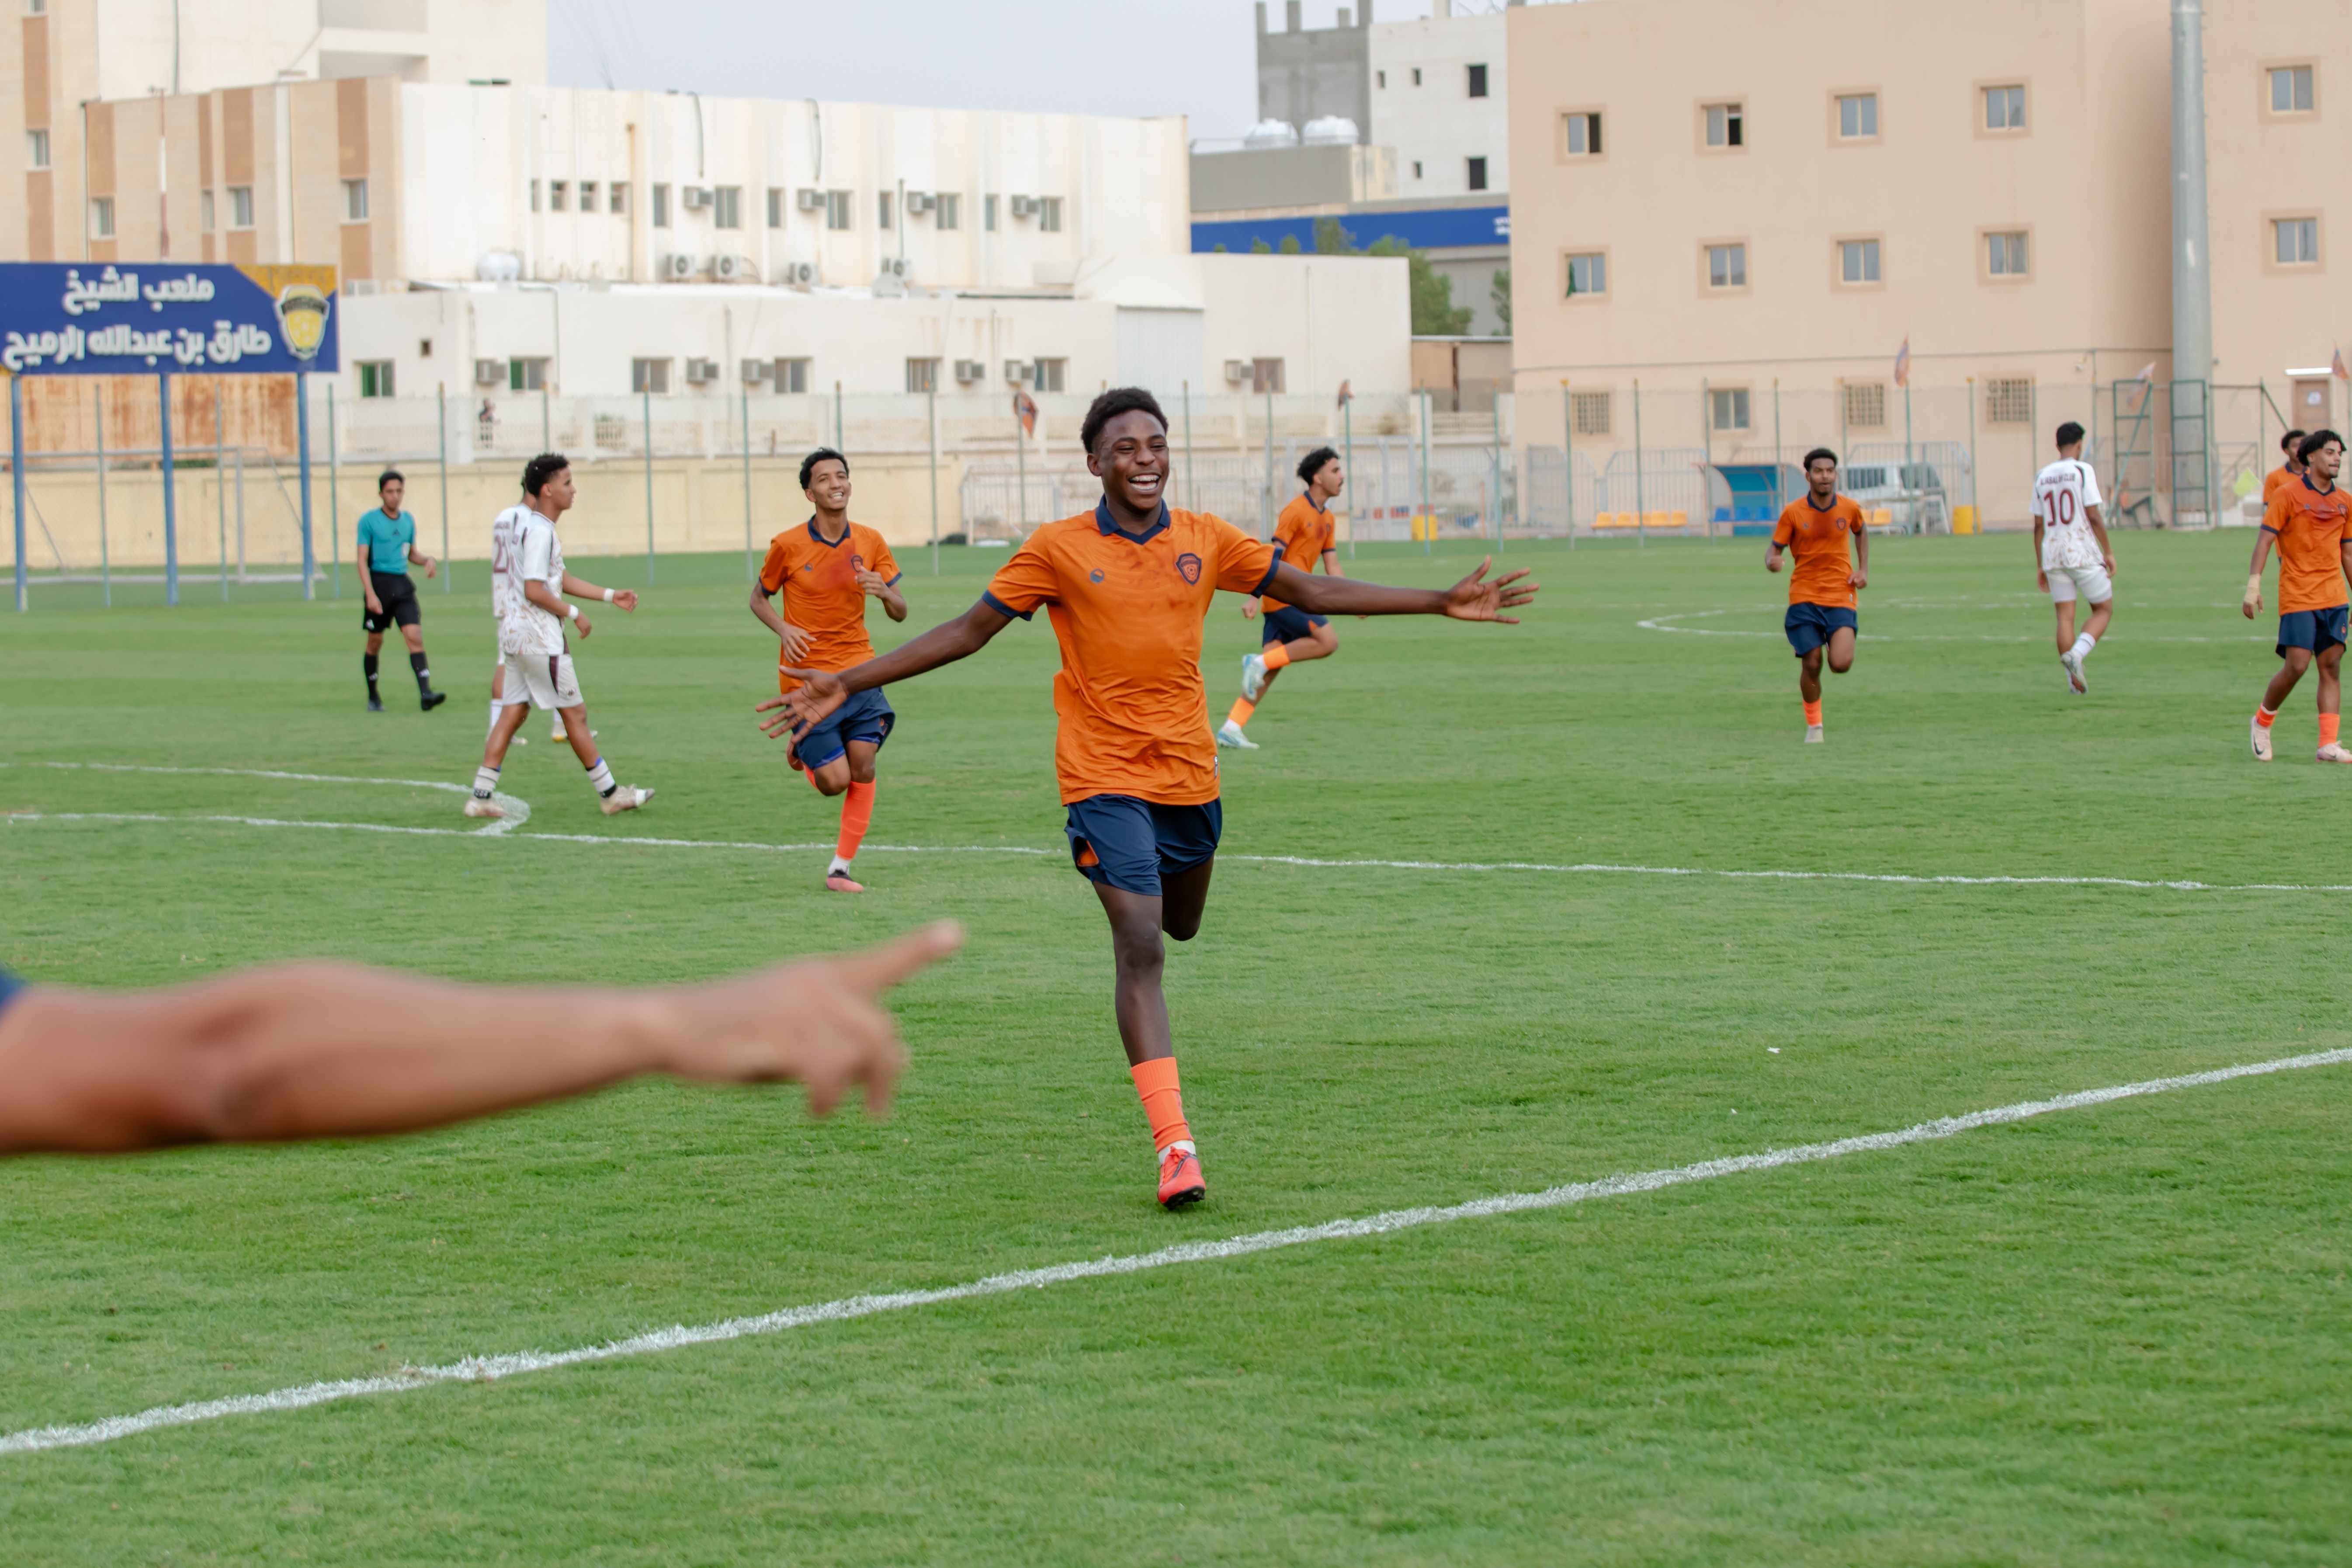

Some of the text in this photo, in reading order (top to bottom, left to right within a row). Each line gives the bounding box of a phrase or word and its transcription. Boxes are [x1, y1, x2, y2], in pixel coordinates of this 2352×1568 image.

[62, 265, 215, 315] ملعب الشيخ
[2, 320, 272, 371] طارق بن عبدالله الرميح
[2043, 489, 2074, 527] 10
